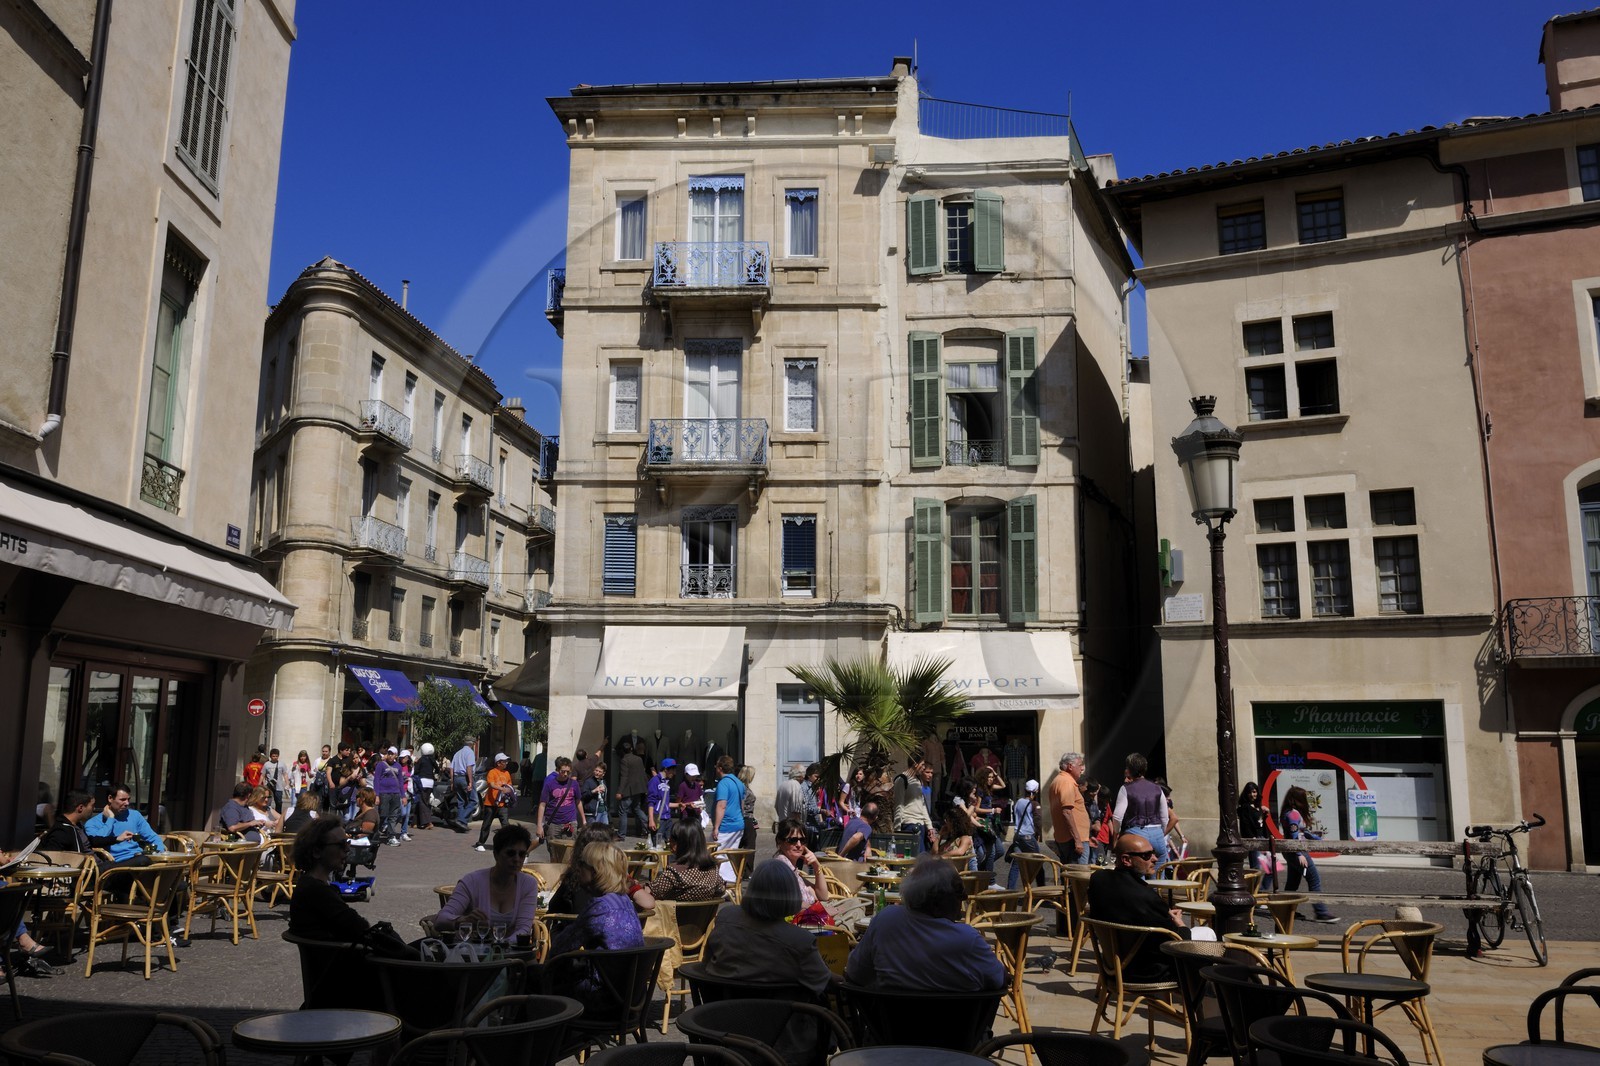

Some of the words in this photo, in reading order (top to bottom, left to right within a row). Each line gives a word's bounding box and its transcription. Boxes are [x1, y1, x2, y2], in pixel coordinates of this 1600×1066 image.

[0, 532, 28, 554] RTS
[352, 667, 381, 680] OXFORD
[604, 676, 728, 688] NEWPORT
[999, 698, 1044, 707] TRUSSARDI
[1292, 704, 1401, 724] Pharmacie
[954, 725, 998, 734] TRUSSARDI
[1308, 724, 1320, 733] de
[1321, 724, 1331, 733] la
[1333, 724, 1385, 733] Cathédrale
[1267, 752, 1305, 766] Clarix
